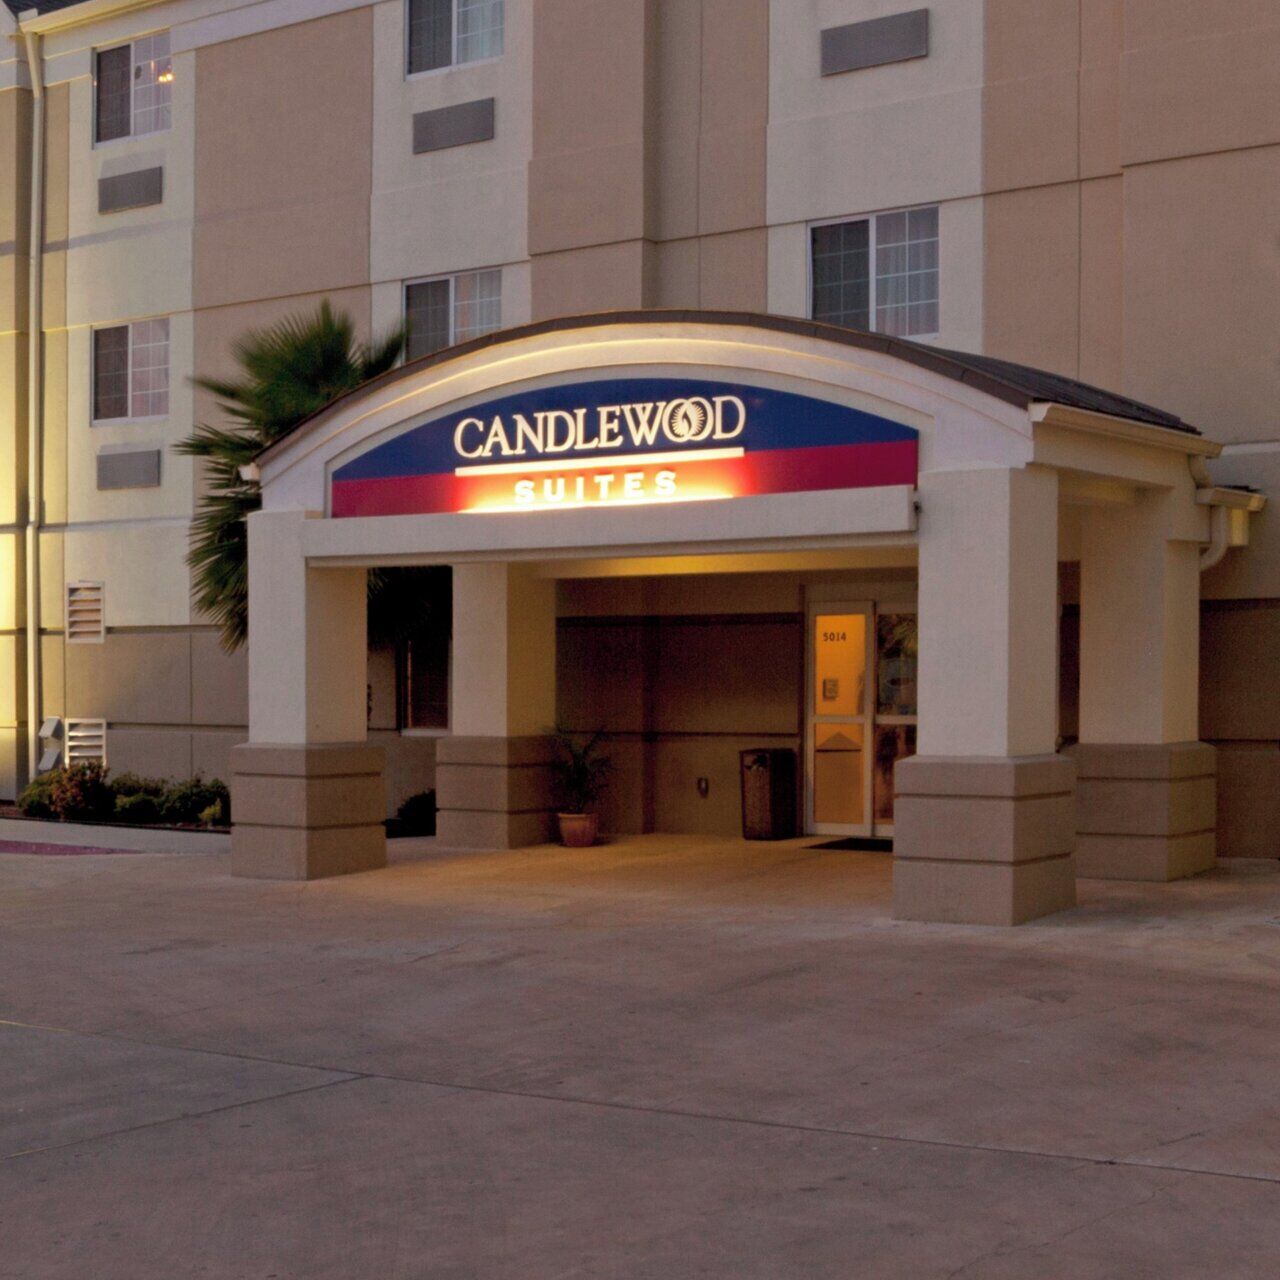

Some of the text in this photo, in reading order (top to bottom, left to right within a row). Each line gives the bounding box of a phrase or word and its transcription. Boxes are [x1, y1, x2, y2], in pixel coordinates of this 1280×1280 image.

[453, 395, 746, 458] CANDLEWOOD
[514, 470, 677, 503] SUITES
[823, 632, 847, 642] 5014
